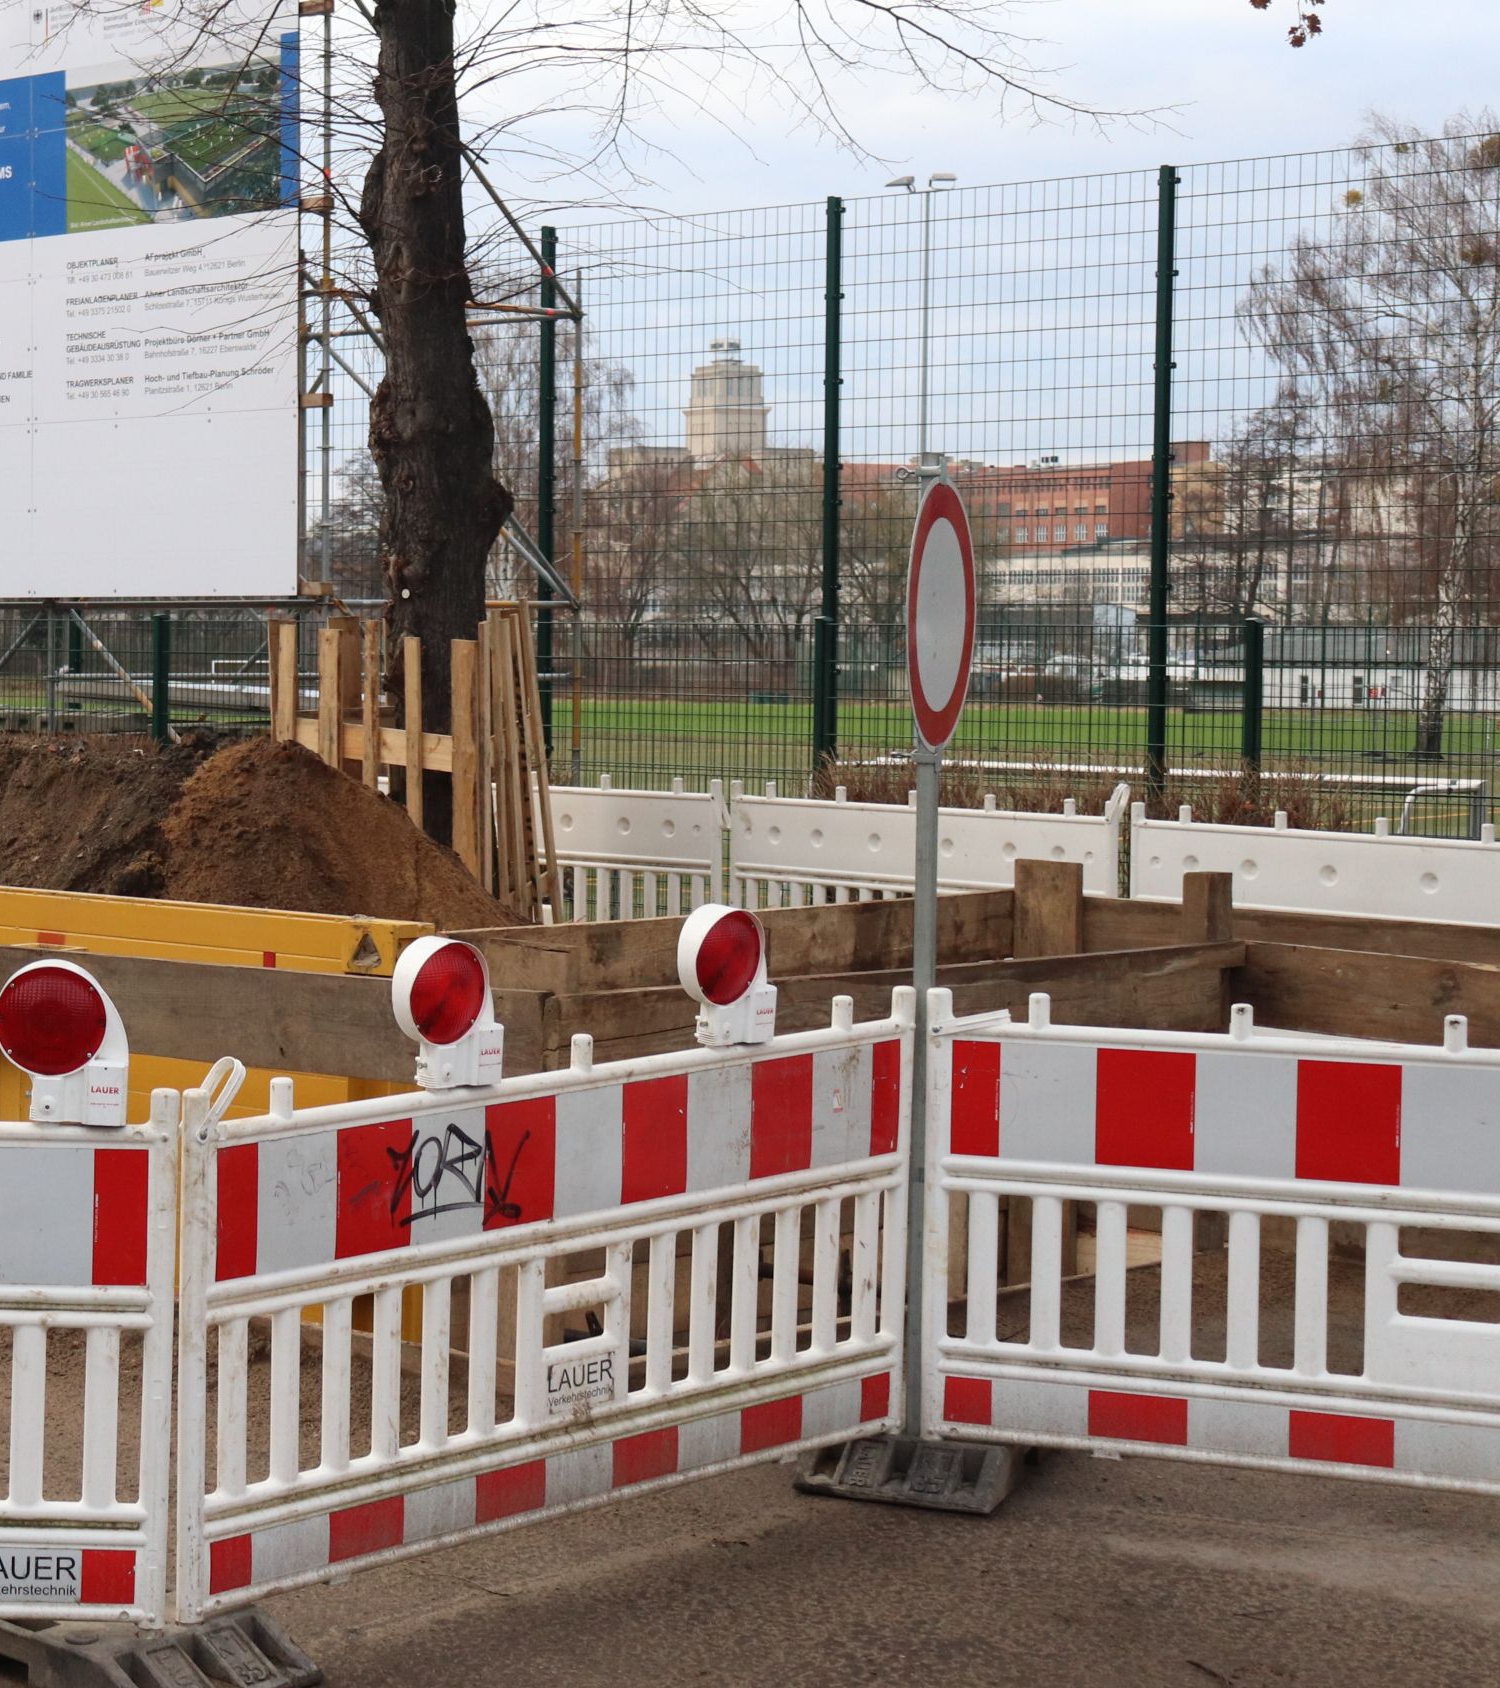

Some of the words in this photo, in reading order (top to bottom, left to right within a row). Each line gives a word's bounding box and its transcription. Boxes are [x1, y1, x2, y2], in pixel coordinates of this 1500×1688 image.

[66, 256, 119, 269] OBJEKTPLANER
[183, 263, 197, 274] Weg
[227, 258, 246, 269] Berlin
[66, 330, 106, 342] TECHNISCHE
[145, 335, 185, 348] Projektbüro
[247, 328, 271, 340] GmbH
[7, 369, 33, 380] FAMILIE
[66, 376, 134, 388] TRAGWERKSPLANER
[145, 373, 166, 385] Hoch-
[167, 372, 181, 382] und
[182, 367, 240, 380] Tiefbau-Planung
[241, 364, 276, 377] Schröder
[481, 1048, 500, 1056] LAUER
[91, 1085, 119, 1095] LAUER
[548, 1358, 614, 1393] LAUER
[547, 1384, 614, 1408] Verkehrstechnik
